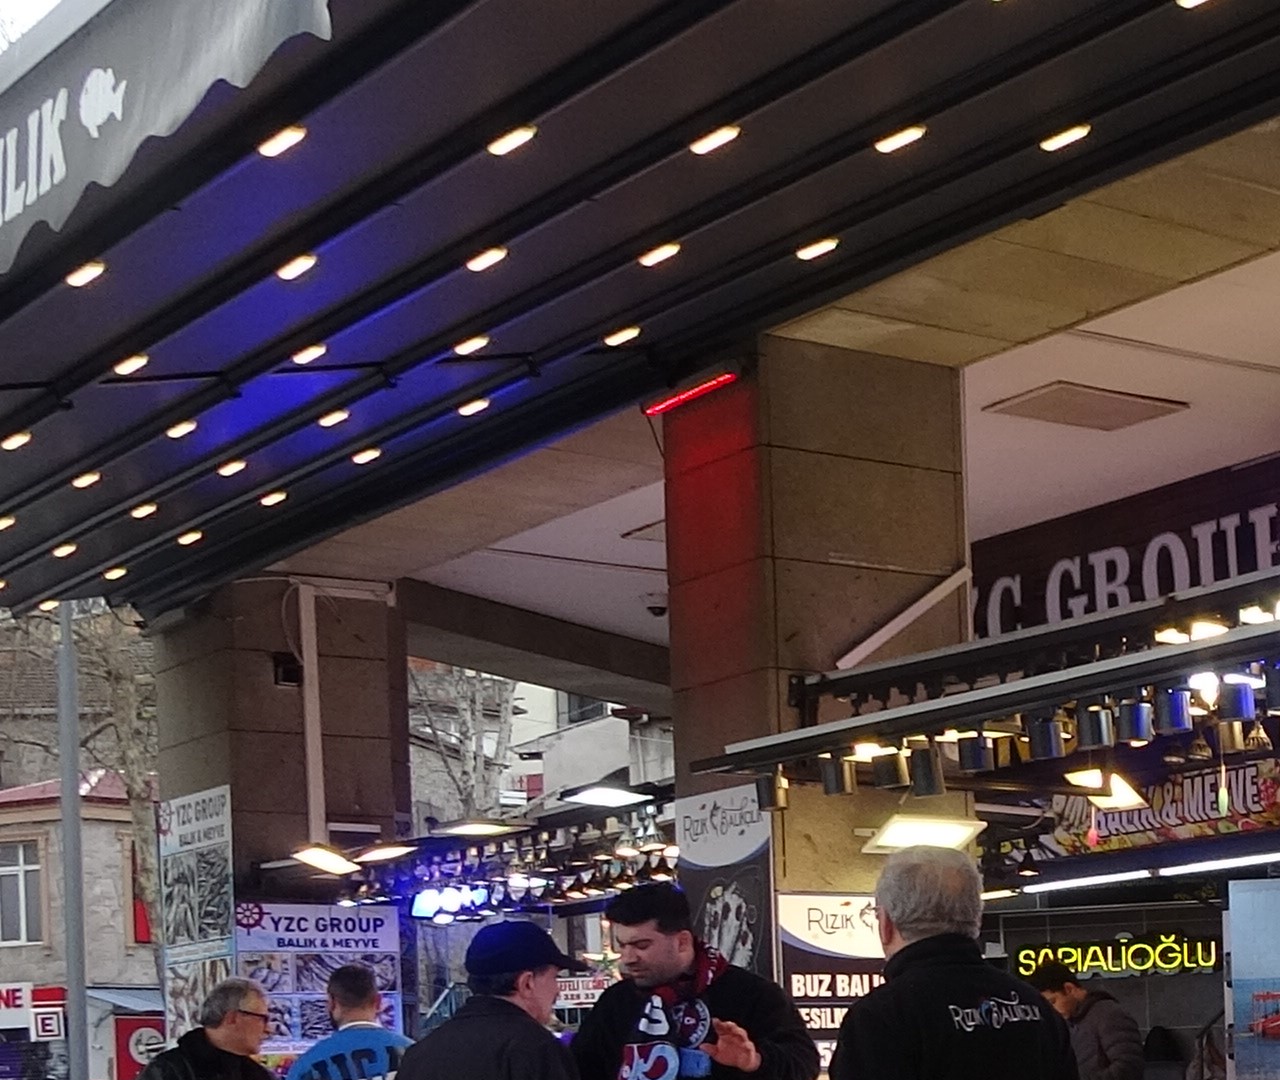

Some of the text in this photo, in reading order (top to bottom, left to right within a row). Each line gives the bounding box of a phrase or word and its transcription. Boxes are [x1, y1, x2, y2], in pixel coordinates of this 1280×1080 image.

[1183, 765, 1265, 823] MEVE
[270, 917, 385, 933] YZC GROUP
[807, 907, 855, 935] RIZIK
[277, 938, 379, 948] BALIK & MEYVE
[791, 974, 832, 997] BUZ
